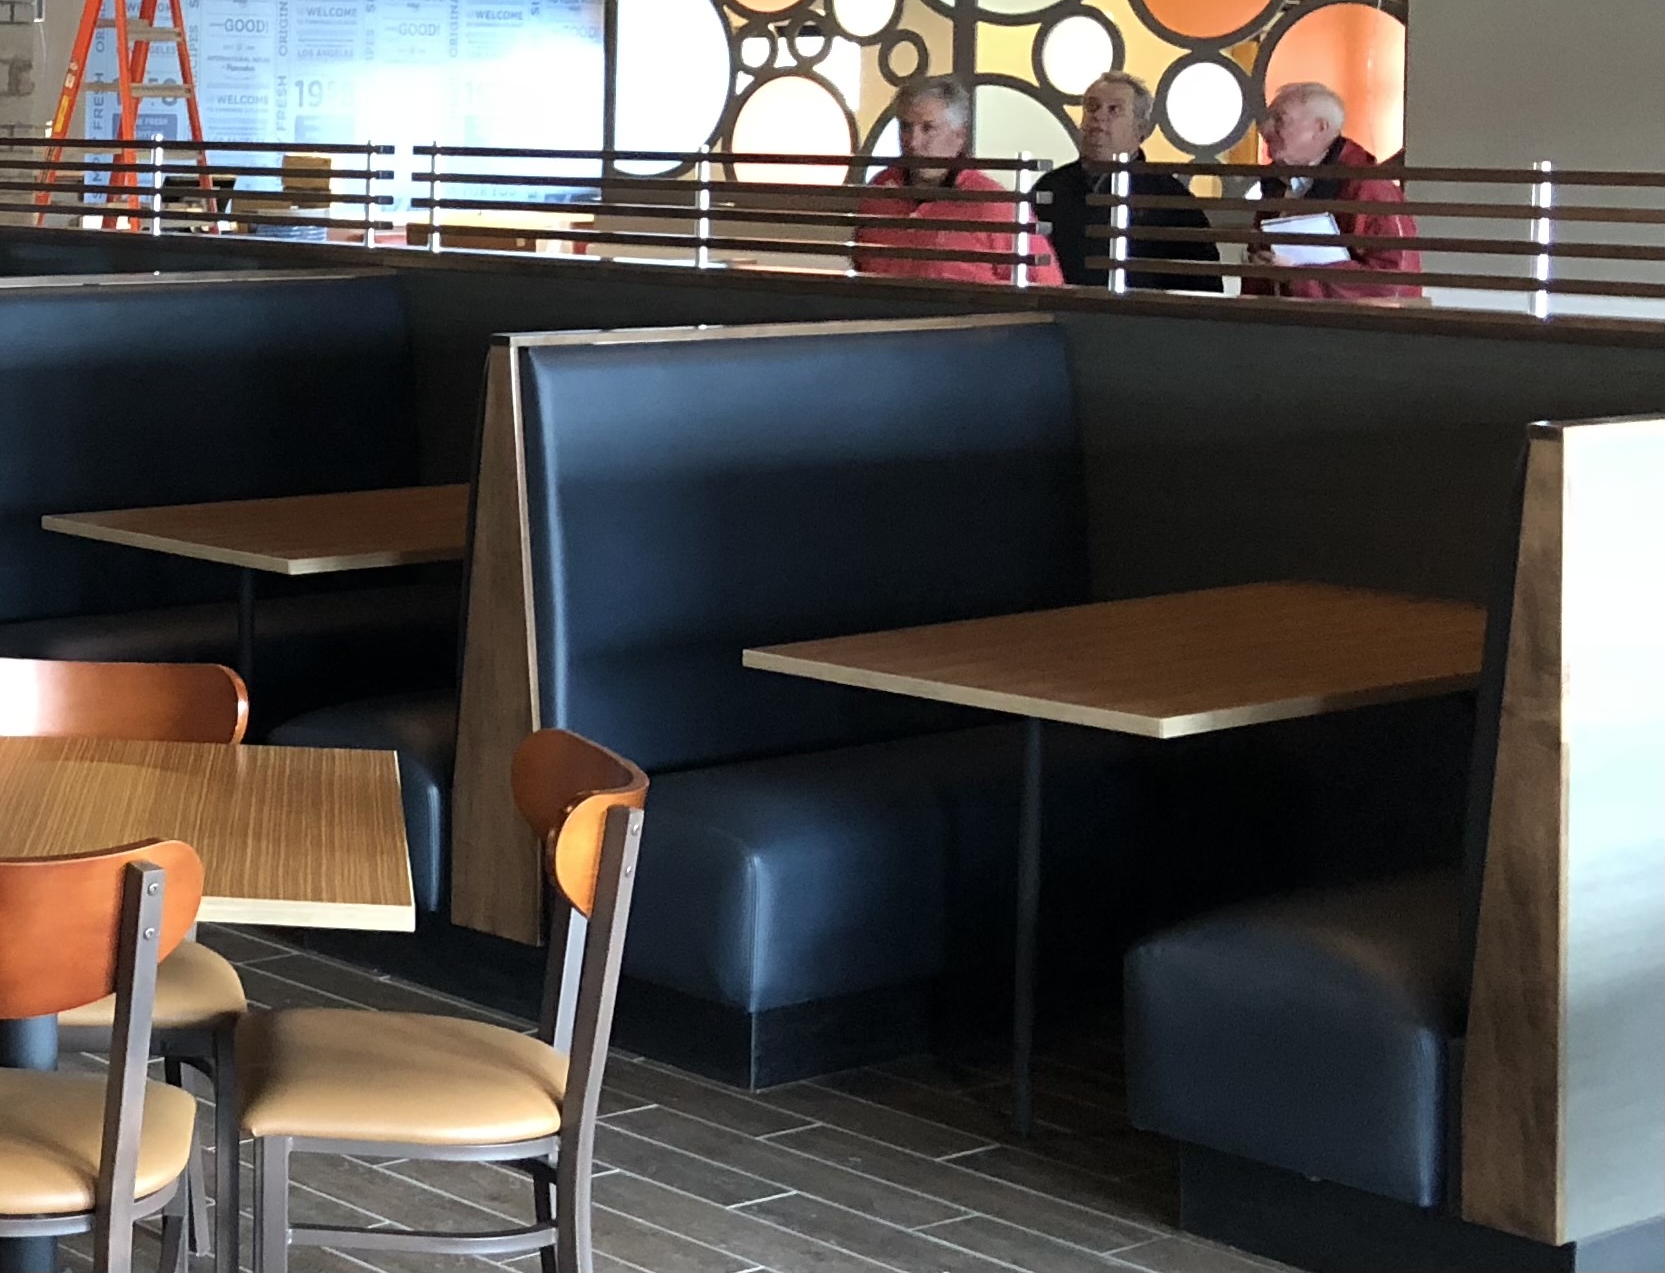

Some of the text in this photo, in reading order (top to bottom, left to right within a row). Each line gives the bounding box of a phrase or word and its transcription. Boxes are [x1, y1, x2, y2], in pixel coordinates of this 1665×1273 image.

[306, 6, 358, 17] WELCOME
[475, 10, 523, 20] WELCOME
[224, 18, 269, 33] GOOD!
[216, 94, 268, 105] WELCOME
[276, 75, 287, 131] FRESH
